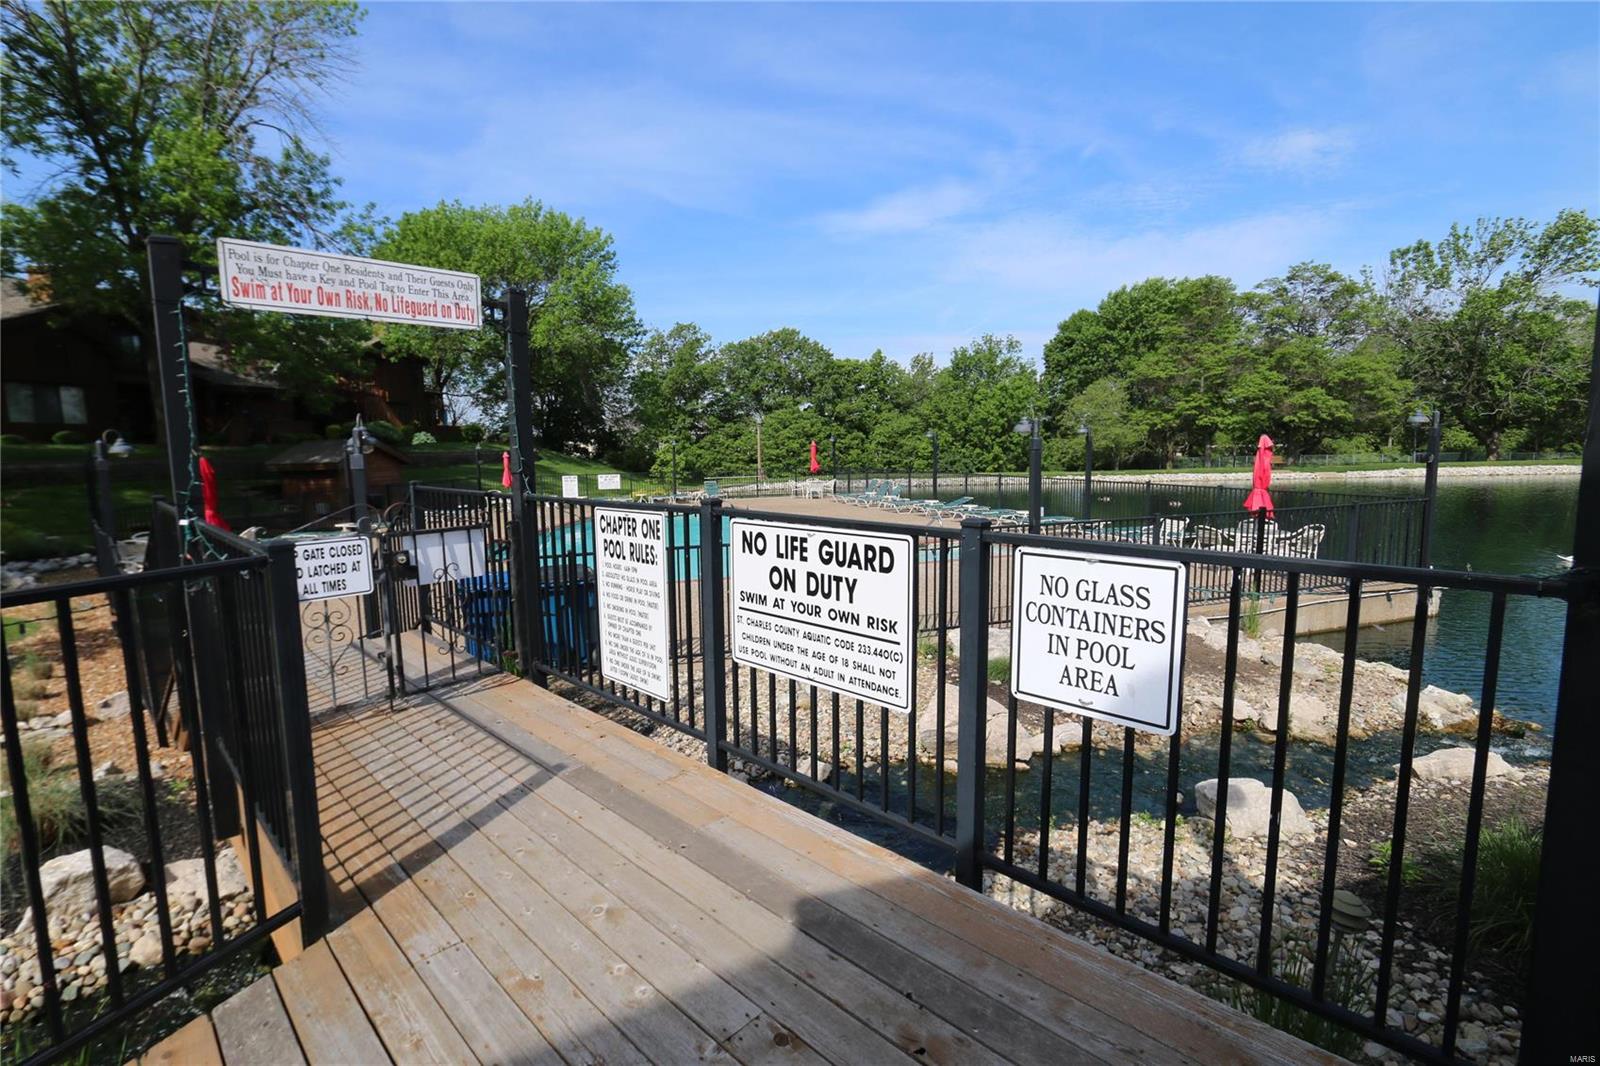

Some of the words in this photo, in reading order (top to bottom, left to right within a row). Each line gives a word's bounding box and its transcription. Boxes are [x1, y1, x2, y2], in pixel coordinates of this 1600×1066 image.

[228, 248, 250, 262] Pool
[254, 252, 263, 263] is
[266, 253, 280, 265] for
[282, 255, 319, 273] Chapter
[322, 261, 341, 273] One
[344, 263, 385, 279] Residents
[388, 268, 403, 281] and
[405, 272, 427, 283] Their
[429, 275, 455, 289] Guests
[235, 263, 254, 276] You
[257, 266, 282, 279] Must
[286, 270, 307, 282] have
[310, 275, 316, 283] a
[319, 274, 335, 287] Key
[339, 276, 355, 287] and
[359, 278, 377, 290] Pool
[380, 281, 395, 295] Tag
[397, 284, 405, 293] to
[408, 285, 429, 296] Enter
[432, 287, 449, 299] This
[231, 276, 266, 300] Swim
[271, 283, 283, 302] at
[287, 283, 312, 304] Your
[317, 286, 341, 307] Own
[346, 289, 372, 313] Risk,
[375, 292, 388, 312] No
[391, 293, 438, 319] Lifeguard
[441, 302, 452, 318] on
[454, 302, 475, 324] Duty
[599, 514, 637, 538] CHAPTER
[641, 518, 661, 541] ONE
[303, 548, 325, 560] GATE
[329, 544, 363, 558] CLOSED
[308, 562, 347, 578] LATCHED
[351, 561, 360, 572] AT
[603, 538, 626, 560] POOL
[629, 542, 658, 566] RULES:
[742, 530, 767, 556] NO
[776, 534, 808, 562] LIFE
[818, 539, 895, 574] GUARD
[303, 583, 318, 596] ALL
[322, 579, 347, 593] TIMES
[769, 565, 797, 593] ON
[806, 571, 858, 604] DUTY
[1040, 574, 1069, 598] NO
[1076, 579, 1151, 610] GLASS
[740, 590, 768, 607] SWIM
[773, 597, 785, 610] AT
[791, 601, 822, 618] YOUR
[828, 609, 860, 626] OWN
[867, 616, 898, 634] RISK
[1026, 601, 1166, 644] CONTAINERS
[737, 616, 745, 624] ST.
[746, 617, 772, 630] CHARLES
[775, 624, 800, 637] COUNTY
[802, 631, 831, 645] AQUATIC
[834, 638, 855, 651] CODE
[858, 643, 903, 664] 233.440(C)
[742, 632, 771, 646] CHILDREN
[774, 641, 794, 653] UNDER
[797, 647, 809, 657] THE
[812, 651, 826, 662] AGE
[829, 656, 838, 665] OF
[841, 659, 849, 667] 18
[852, 661, 875, 675] SHALL
[879, 668, 896, 680] NOT
[1047, 633, 1070, 657] IN
[1076, 638, 1136, 670] POOL
[738, 645, 750, 655] USE
[751, 648, 767, 660] POOL
[770, 653, 797, 668] WITHOUT
[800, 662, 811, 672] AN
[814, 666, 834, 679] ADULT
[838, 672, 845, 682] IN
[848, 675, 901, 699] ATTENDANCE.
[1059, 665, 1120, 697] AREA
